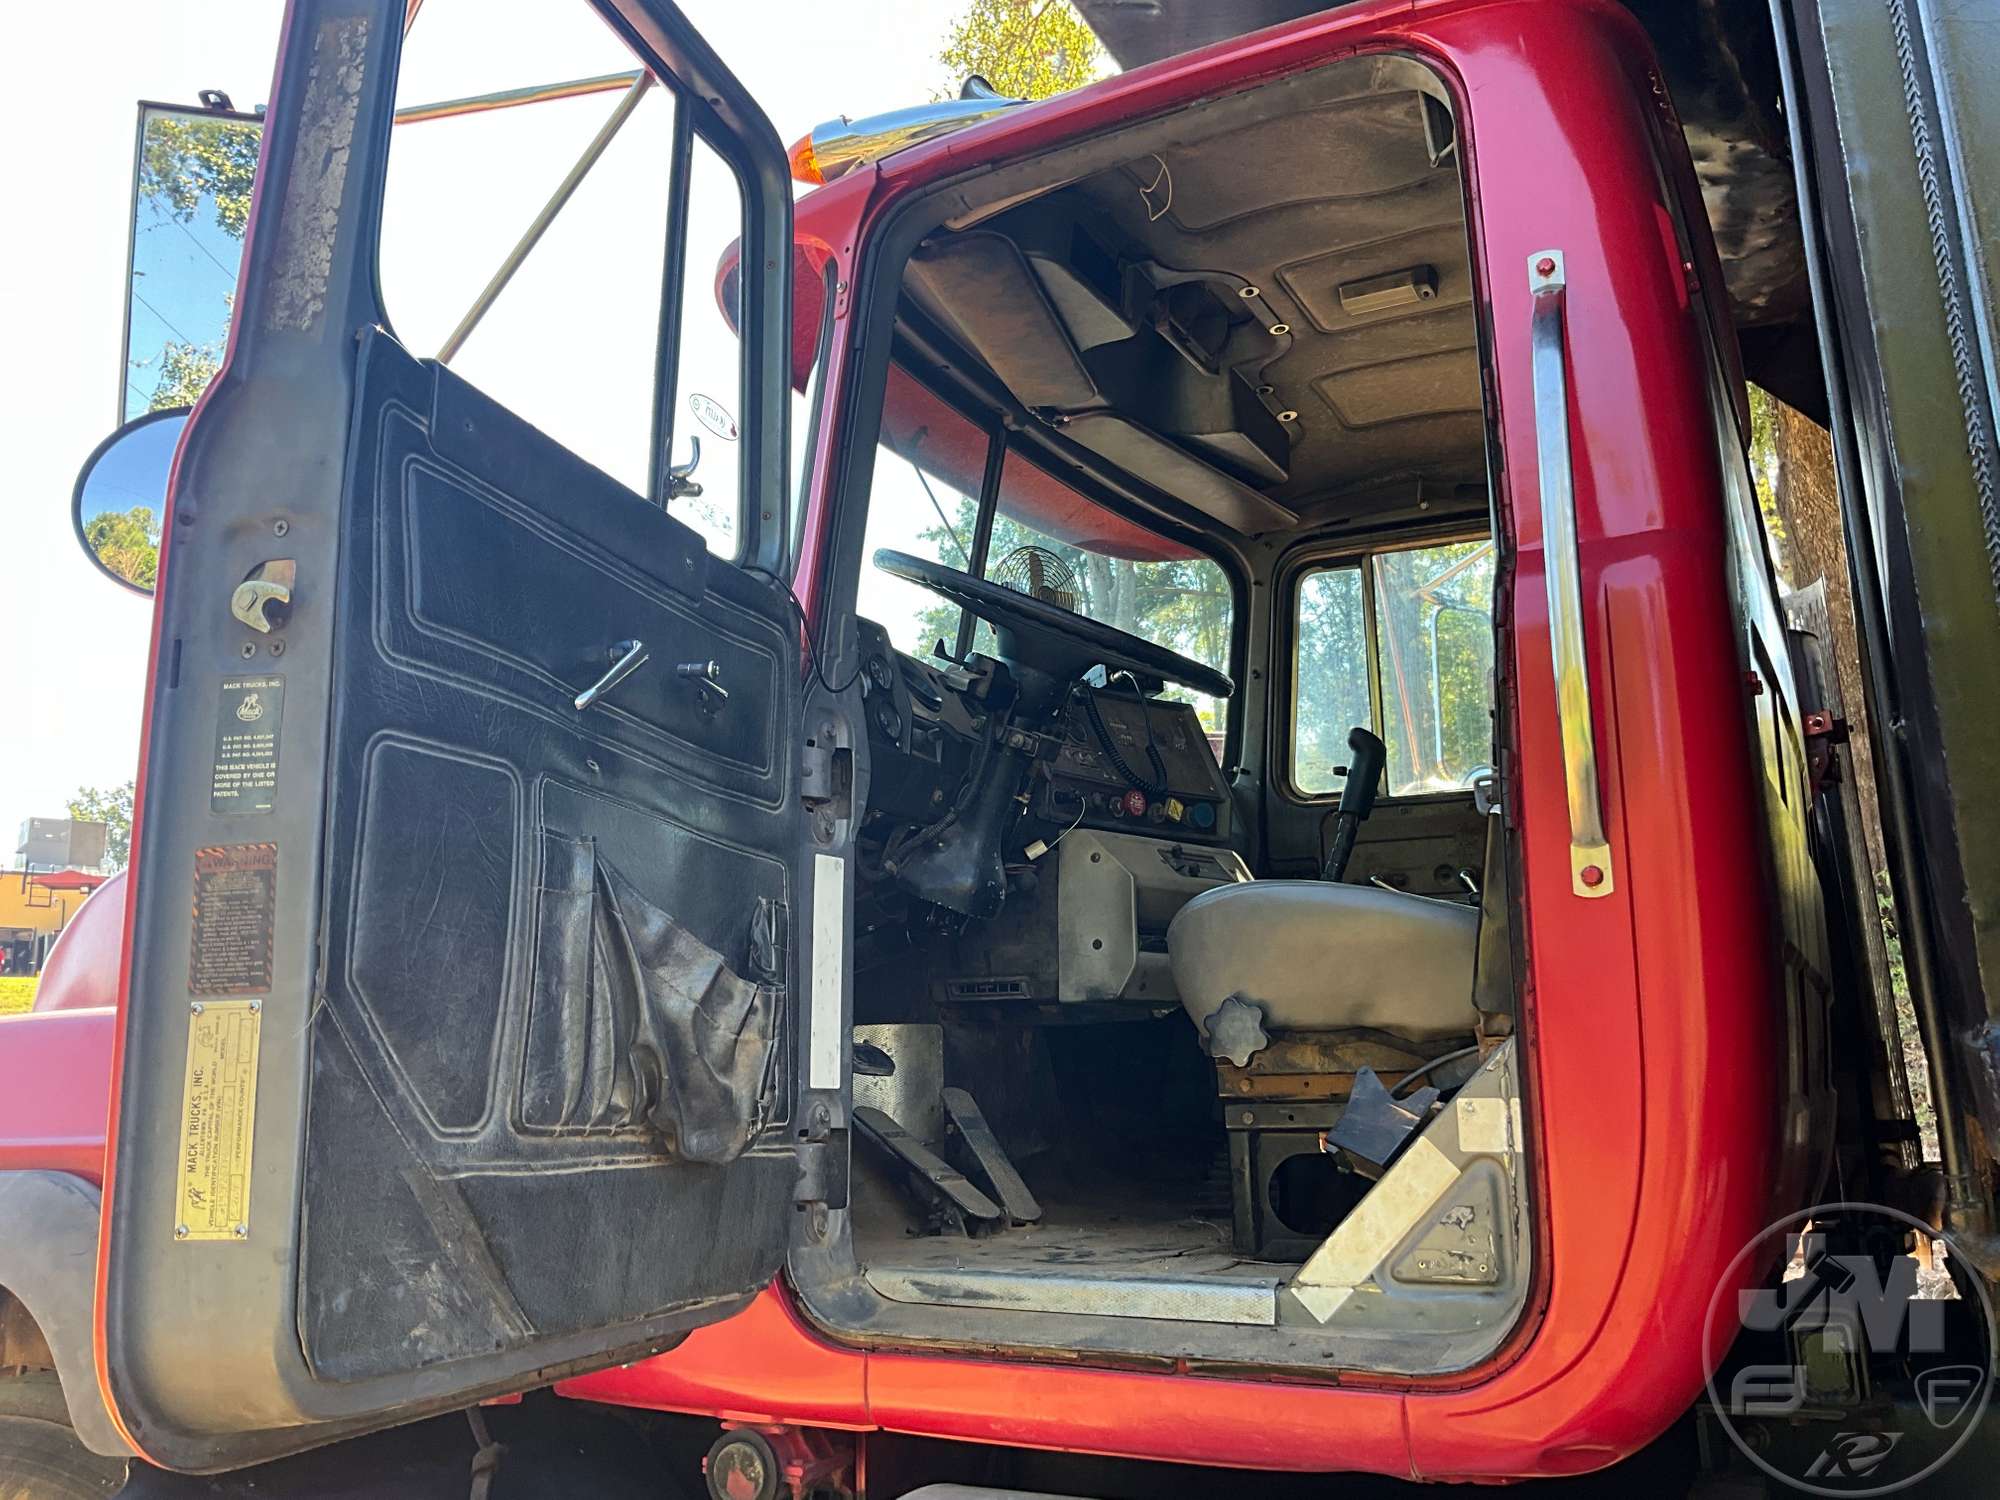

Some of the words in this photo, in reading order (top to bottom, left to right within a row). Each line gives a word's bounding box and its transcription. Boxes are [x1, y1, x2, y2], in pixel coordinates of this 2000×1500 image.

[212, 854, 271, 867] WANING
[194, 1067, 203, 1087] INC.
[189, 1092, 202, 1136] TRUCKS,
[209, 1102, 214, 1110] OF
[187, 1143, 197, 1173] MACK
[210, 1144, 218, 1196] IDENTIFICATION
